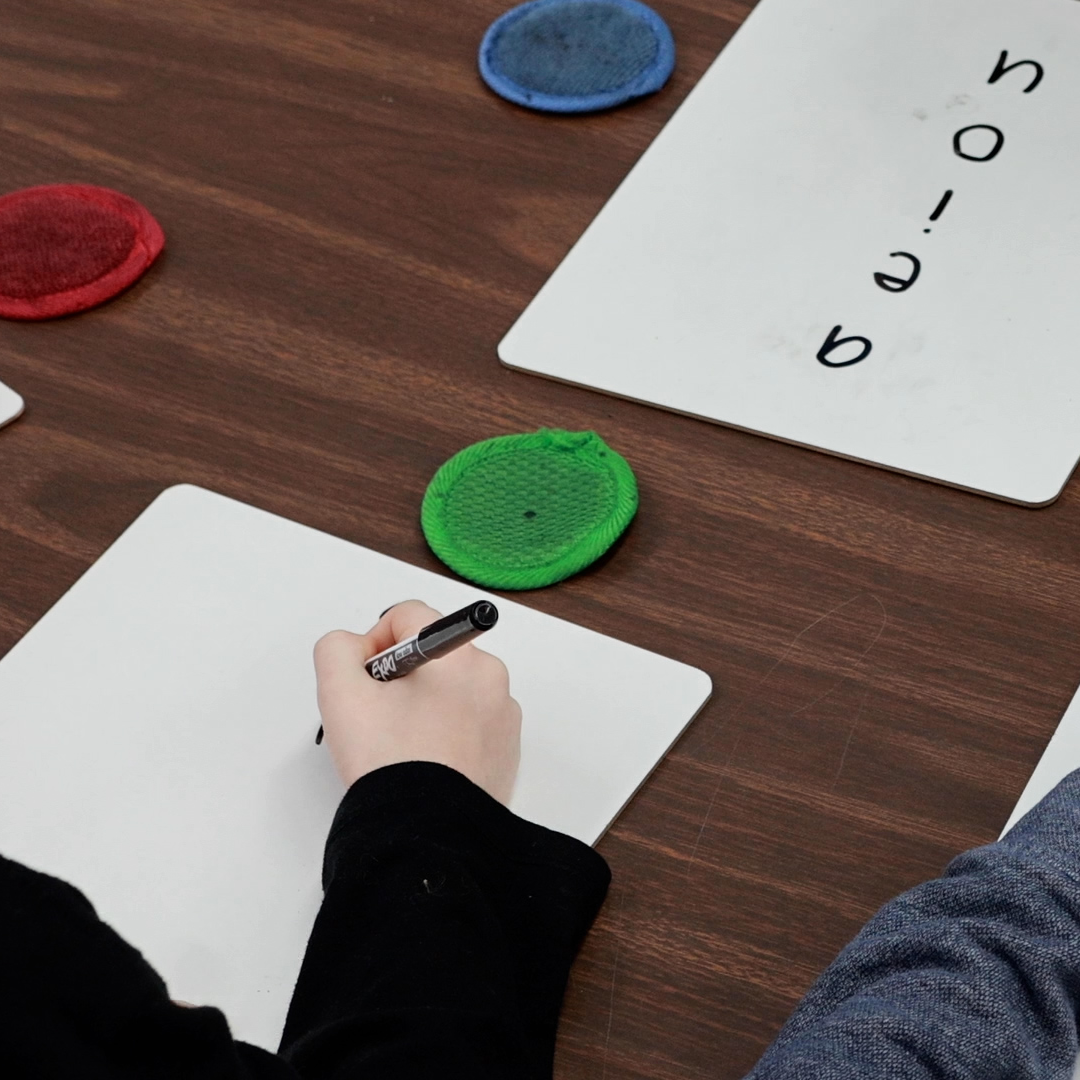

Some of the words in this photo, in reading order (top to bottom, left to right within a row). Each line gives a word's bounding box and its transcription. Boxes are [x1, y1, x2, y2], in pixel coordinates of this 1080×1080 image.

[816, 324, 873, 368] a
[873, 251, 921, 293] e
[923, 189, 954, 234] i
[953, 124, 1005, 162] o
[987, 49, 1044, 93] u
